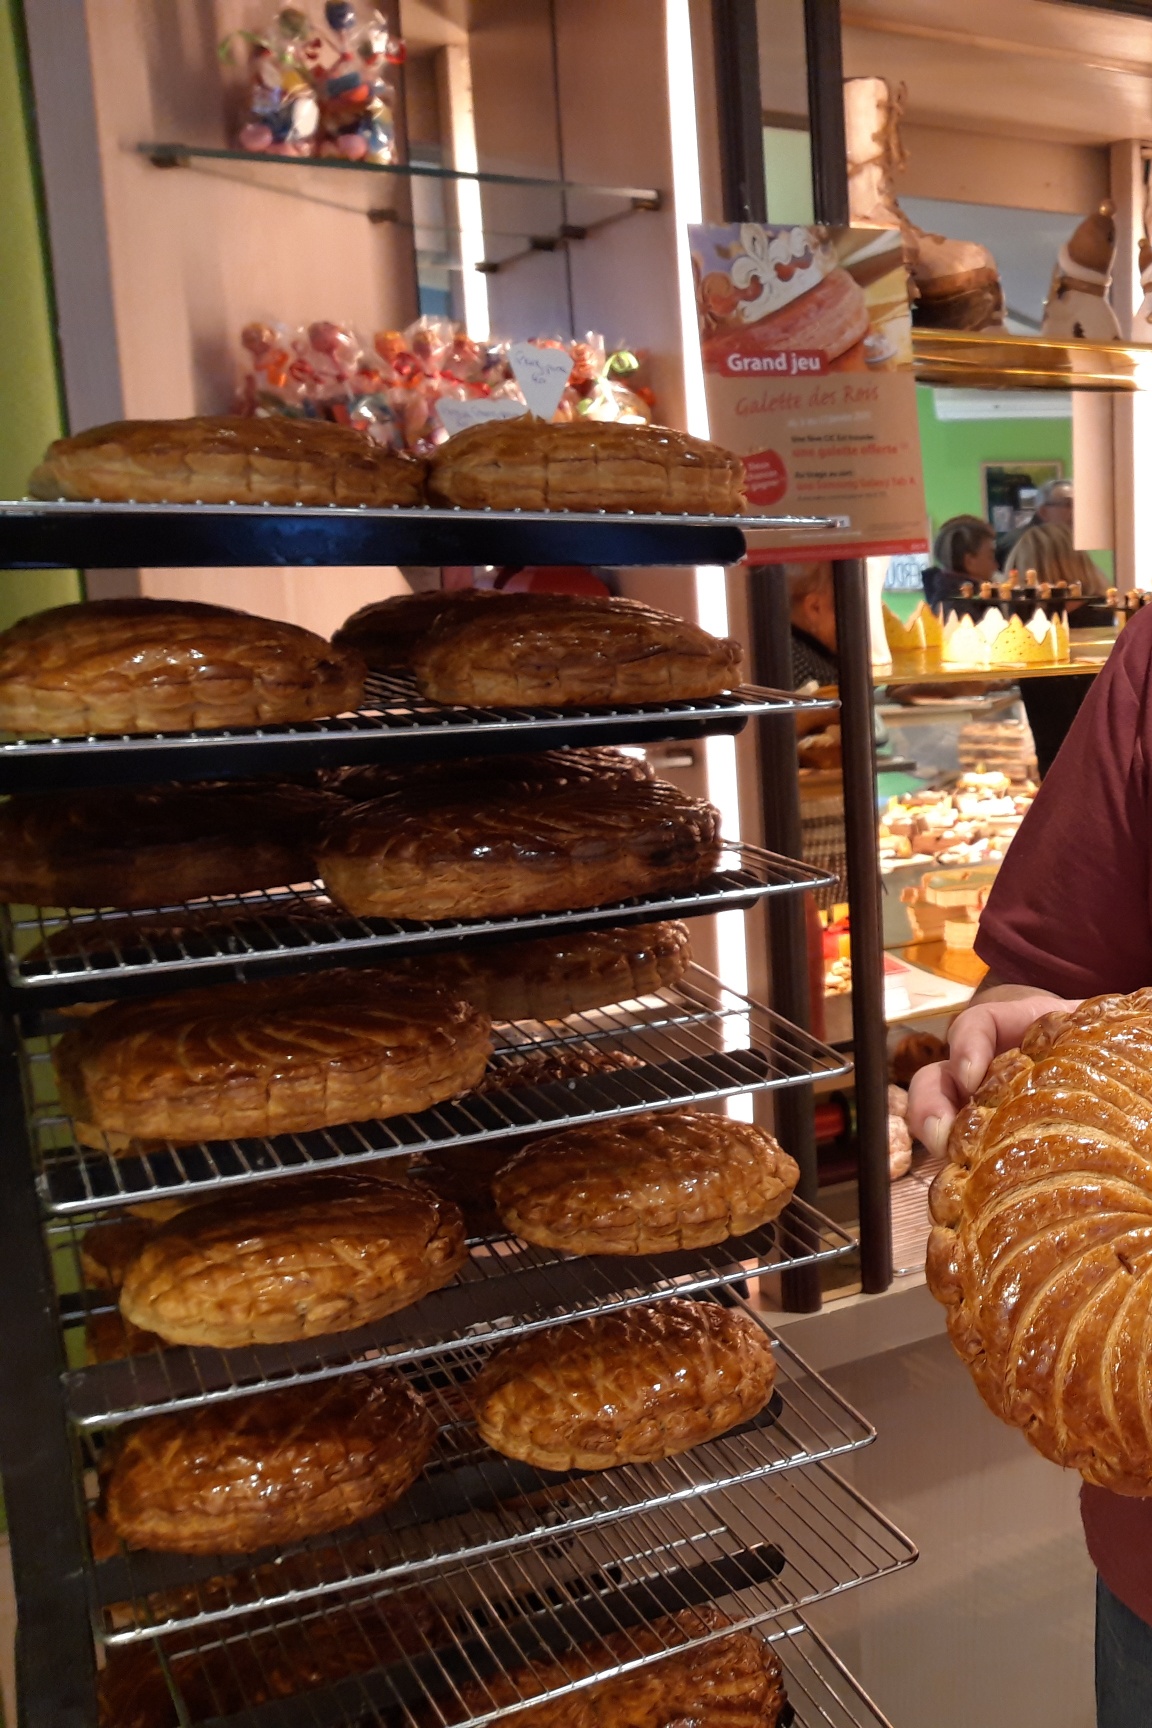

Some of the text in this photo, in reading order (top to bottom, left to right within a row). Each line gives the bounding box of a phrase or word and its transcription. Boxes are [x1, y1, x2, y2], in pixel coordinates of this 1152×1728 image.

[727, 352, 821, 375] Grand jeu
[734, 390, 801, 416] Galette
[808, 386, 836, 407] des
